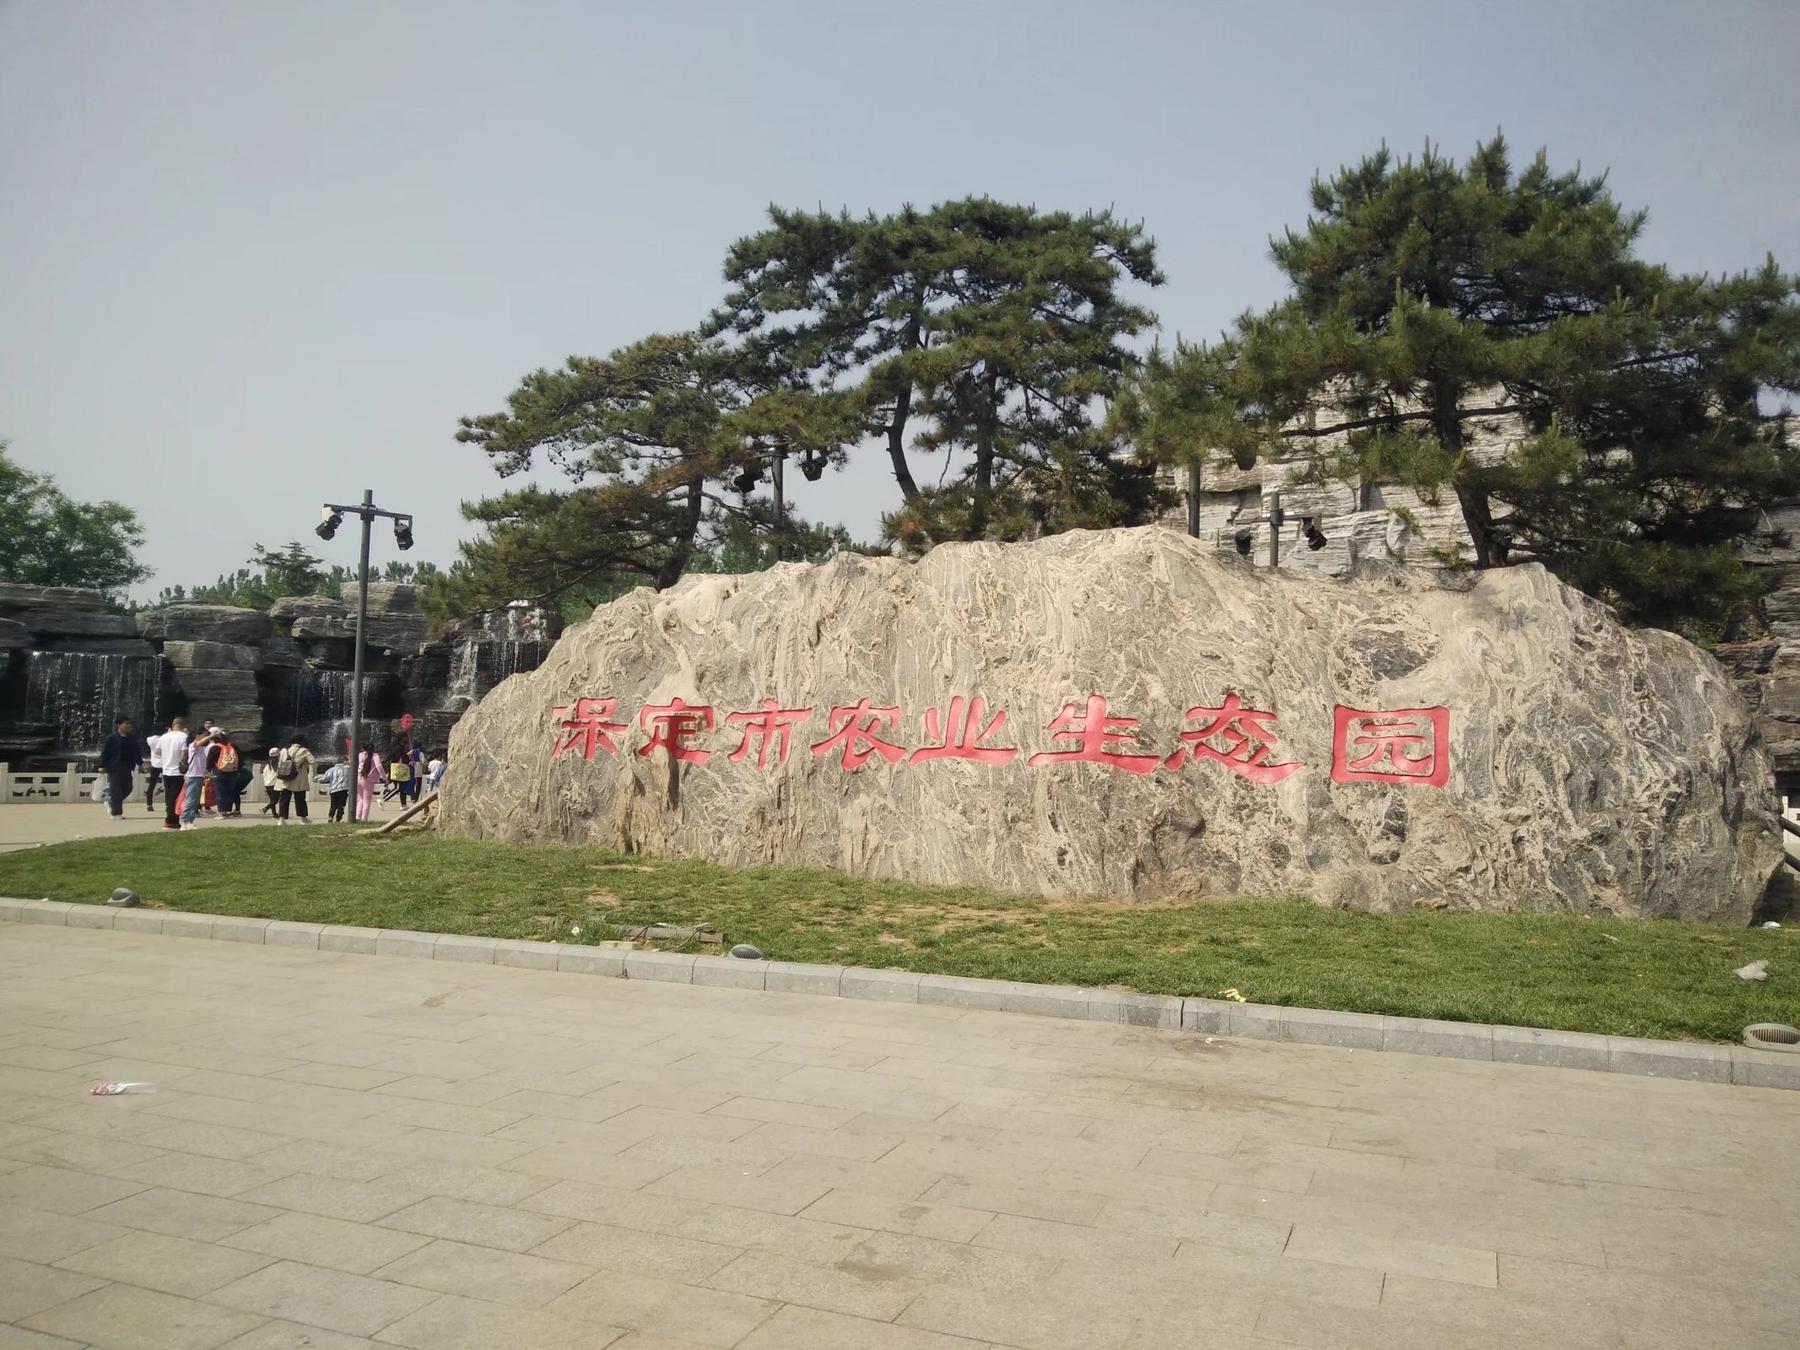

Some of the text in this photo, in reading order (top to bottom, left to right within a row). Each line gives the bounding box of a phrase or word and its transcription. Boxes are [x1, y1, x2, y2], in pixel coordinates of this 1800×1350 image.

[552, 693, 1451, 789] 保定市农业生态园
